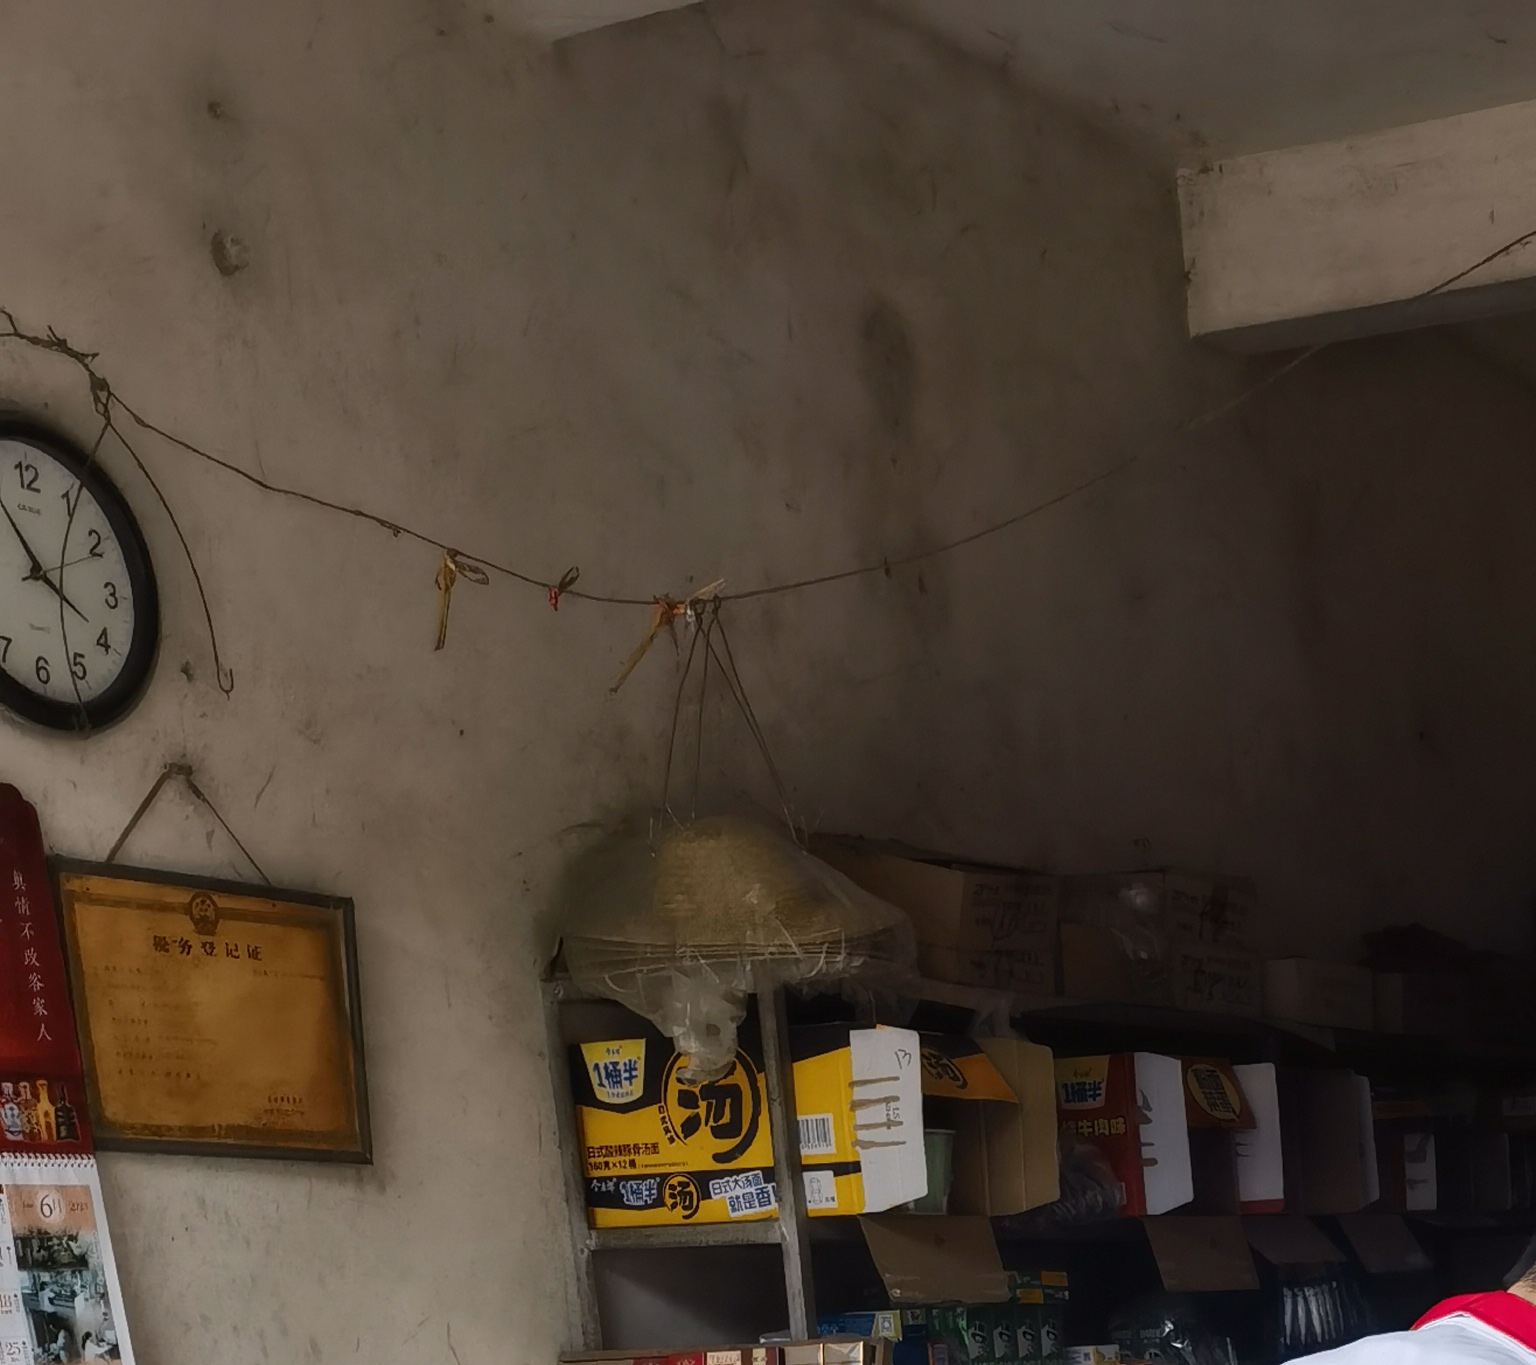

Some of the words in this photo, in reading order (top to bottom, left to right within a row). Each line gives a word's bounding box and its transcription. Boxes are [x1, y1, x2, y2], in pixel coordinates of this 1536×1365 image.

[15, 460, 41, 494] 12
[88, 529, 103, 558] 2
[104, 581, 118, 609] 3
[97, 627, 111, 655] 4
[35, 656, 51, 685] 6
[71, 652, 87, 681] 5
